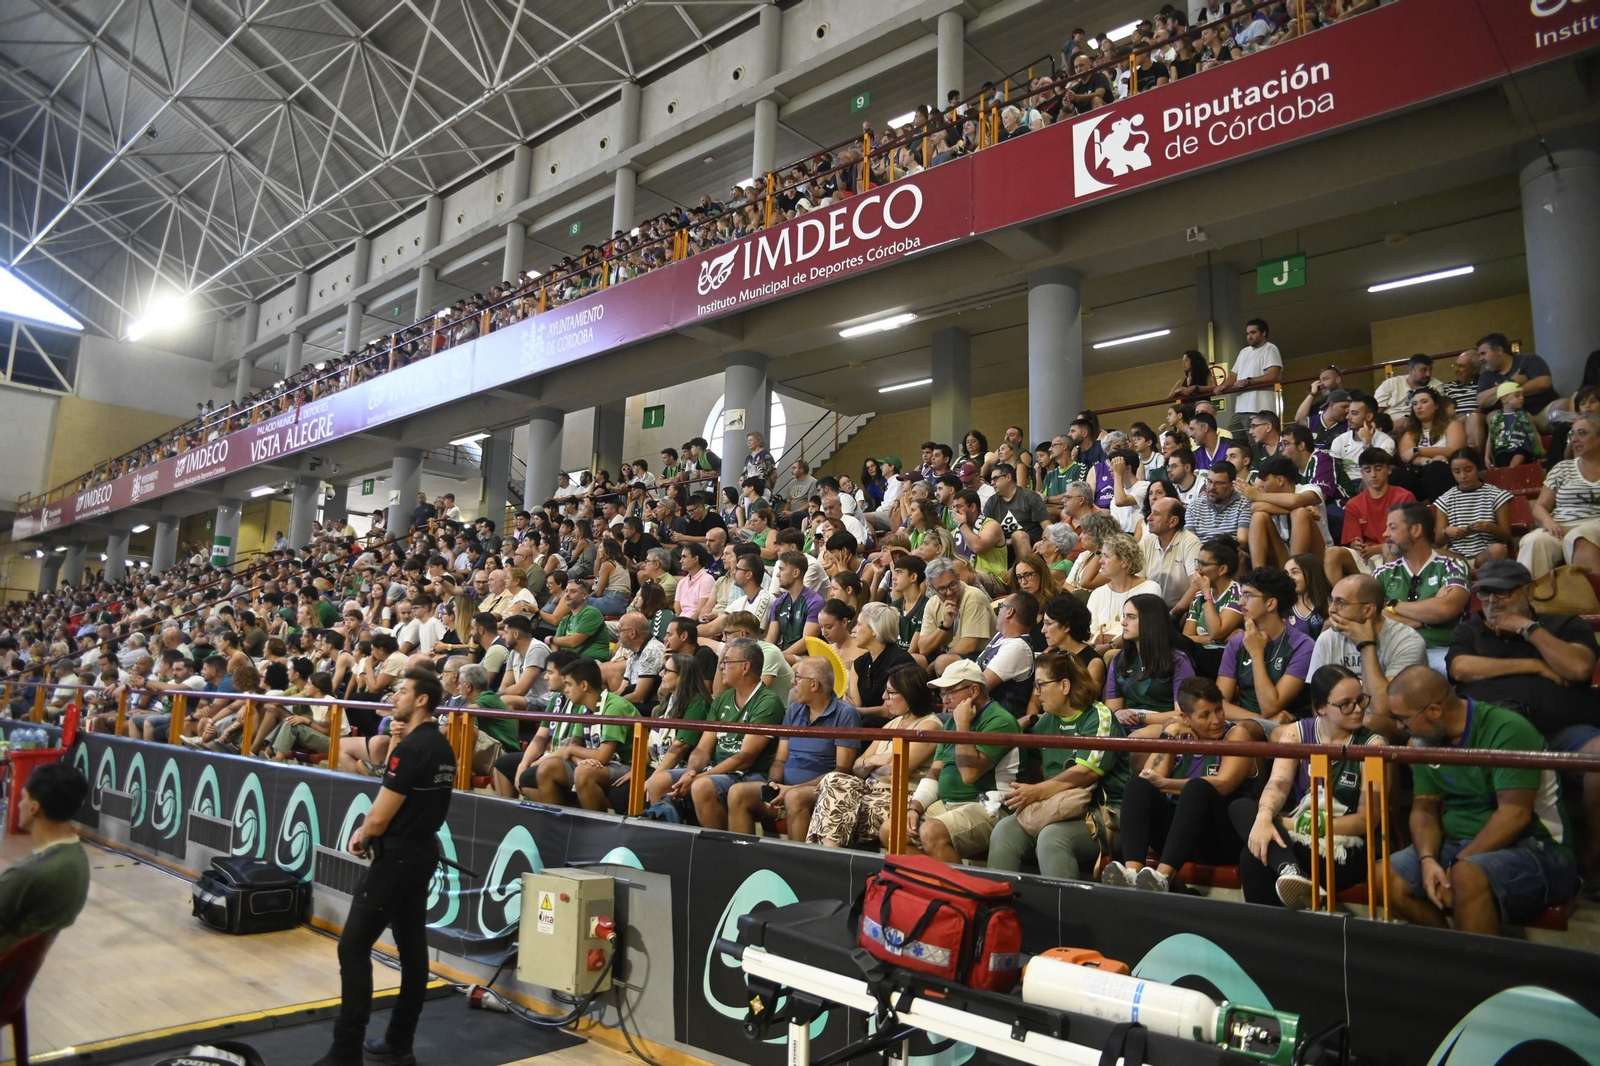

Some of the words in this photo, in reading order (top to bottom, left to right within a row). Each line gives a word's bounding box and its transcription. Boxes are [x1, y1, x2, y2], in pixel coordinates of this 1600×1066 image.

[856, 96, 865, 108] 9
[1163, 62, 1330, 133] Diputación
[1165, 135, 1199, 160] de
[1208, 92, 1335, 146] Córdoba
[572, 223, 578, 234] 8
[743, 183, 924, 280] IMDECO
[697, 291, 737, 316] Instituto
[739, 278, 791, 303] Municipal
[792, 272, 807, 285] de
[810, 254, 864, 281] Deportes
[866, 236, 922, 263] Córdoba
[1272, 260, 1289, 286] J
[548, 304, 604, 337] AYUNTAMIENTO
[557, 326, 595, 352] CÓRDOBA
[257, 421, 277, 437] PALACIO
[276, 411, 303, 430] MUNICIL
[303, 401, 329, 419] DEPORTES
[251, 433, 281, 462] VISTA
[283, 413, 335, 451] ALEGRE
[186, 439, 229, 474] IMDECO
[83, 483, 113, 509] IMDECO
